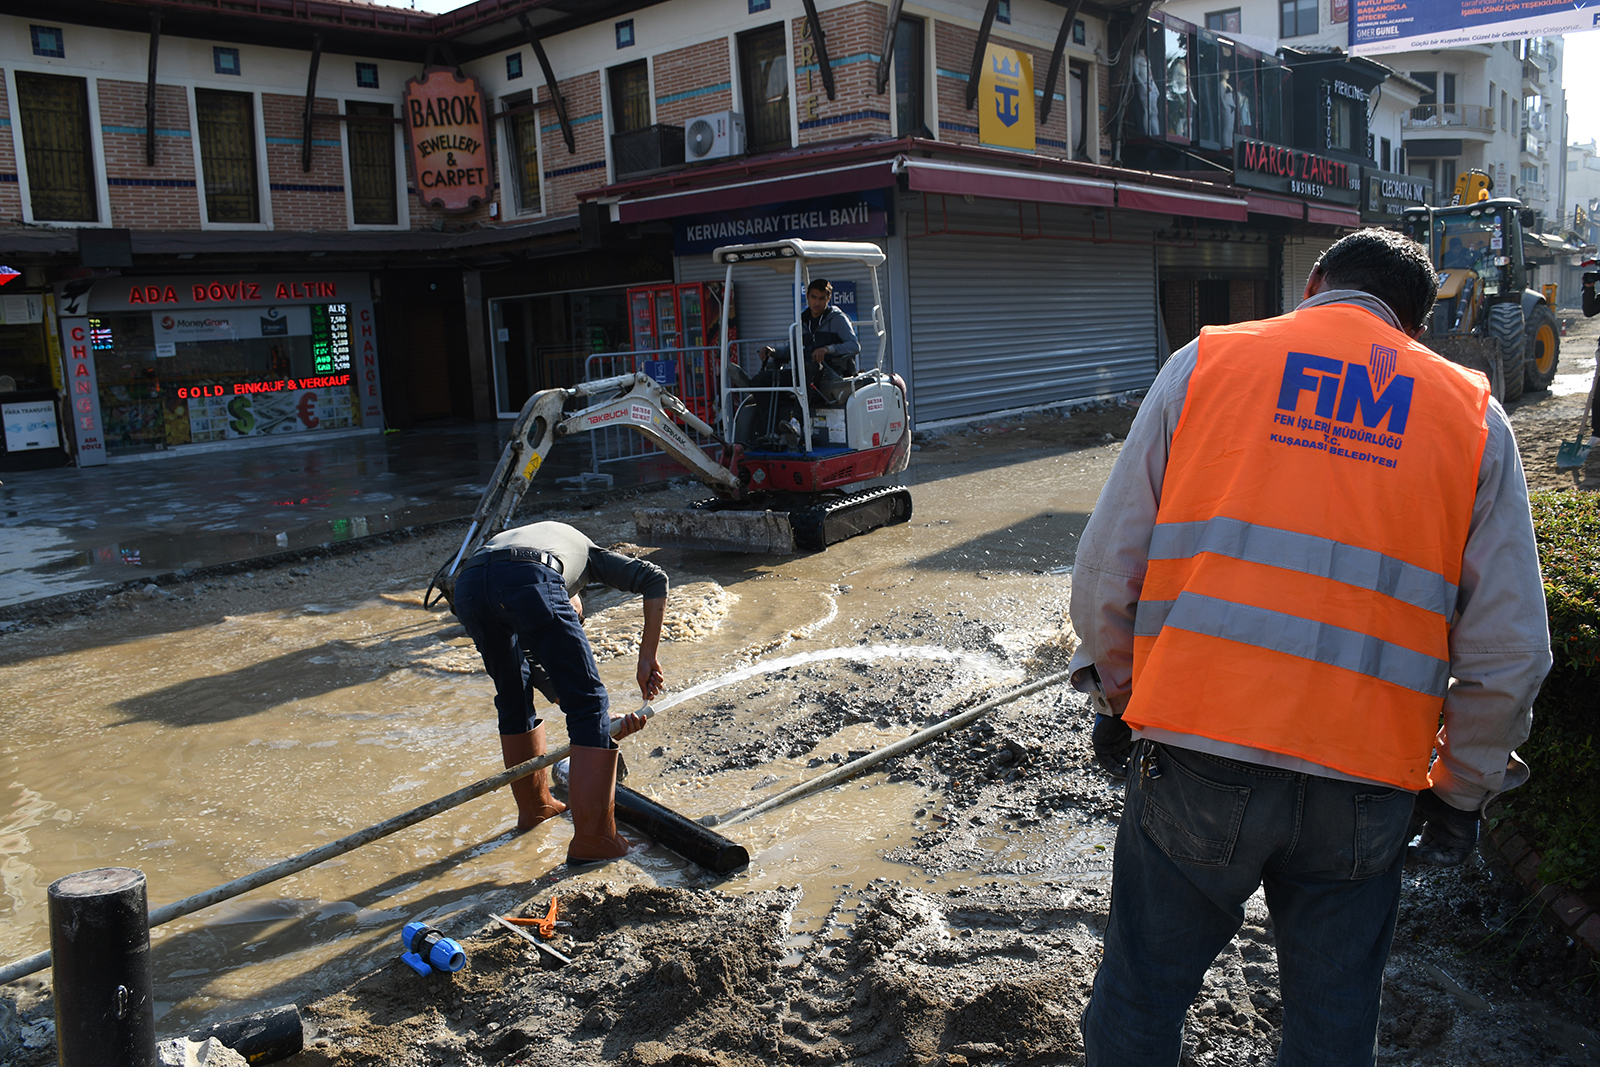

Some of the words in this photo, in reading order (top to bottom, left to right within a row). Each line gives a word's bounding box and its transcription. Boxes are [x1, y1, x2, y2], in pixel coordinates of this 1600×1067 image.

[1357, 13, 1387, 22] BİTECEK
[1376, 26, 1399, 36] GÜNEL
[1410, 40, 1429, 48] Güçlü
[1472, 33, 1491, 41] Güzel
[1502, 29, 1528, 37] Gelecek
[410, 96, 480, 128] BAROK
[417, 134, 482, 158] JEWELLERY
[447, 152, 457, 166] &
[1302, 153, 1350, 188] ZANETTI
[421, 168, 484, 188] CARPET
[1292, 180, 1323, 198] BUSINESS
[1382, 180, 1413, 201] CLEOPATRA
[1414, 184, 1424, 204] INK
[687, 216, 780, 242] KERVANSARAY
[782, 212, 827, 232] TEKEL
[129, 285, 179, 304] ADA
[192, 280, 262, 303] DÖVİZ
[275, 282, 336, 300] ALTIN
[834, 292, 855, 304] Erikli
[178, 318, 229, 328] MoneyGram
[360, 310, 378, 396] CHANGE
[70, 327, 94, 430] CHANGE
[178, 385, 224, 399] GOLD
[287, 380, 298, 391] &
[298, 374, 350, 389] VERKAUF
[1274, 413, 1296, 427] FEN
[1298, 415, 1332, 434] İŞLERİ
[1332, 425, 1402, 450] MÜDÜRLÜĞÜ
[1324, 434, 1340, 447] T.C.
[82, 442, 102, 450] DÖVİZ
[1270, 434, 1328, 451] KUŞADASI
[1329, 446, 1398, 468] BELEDİYESİ
